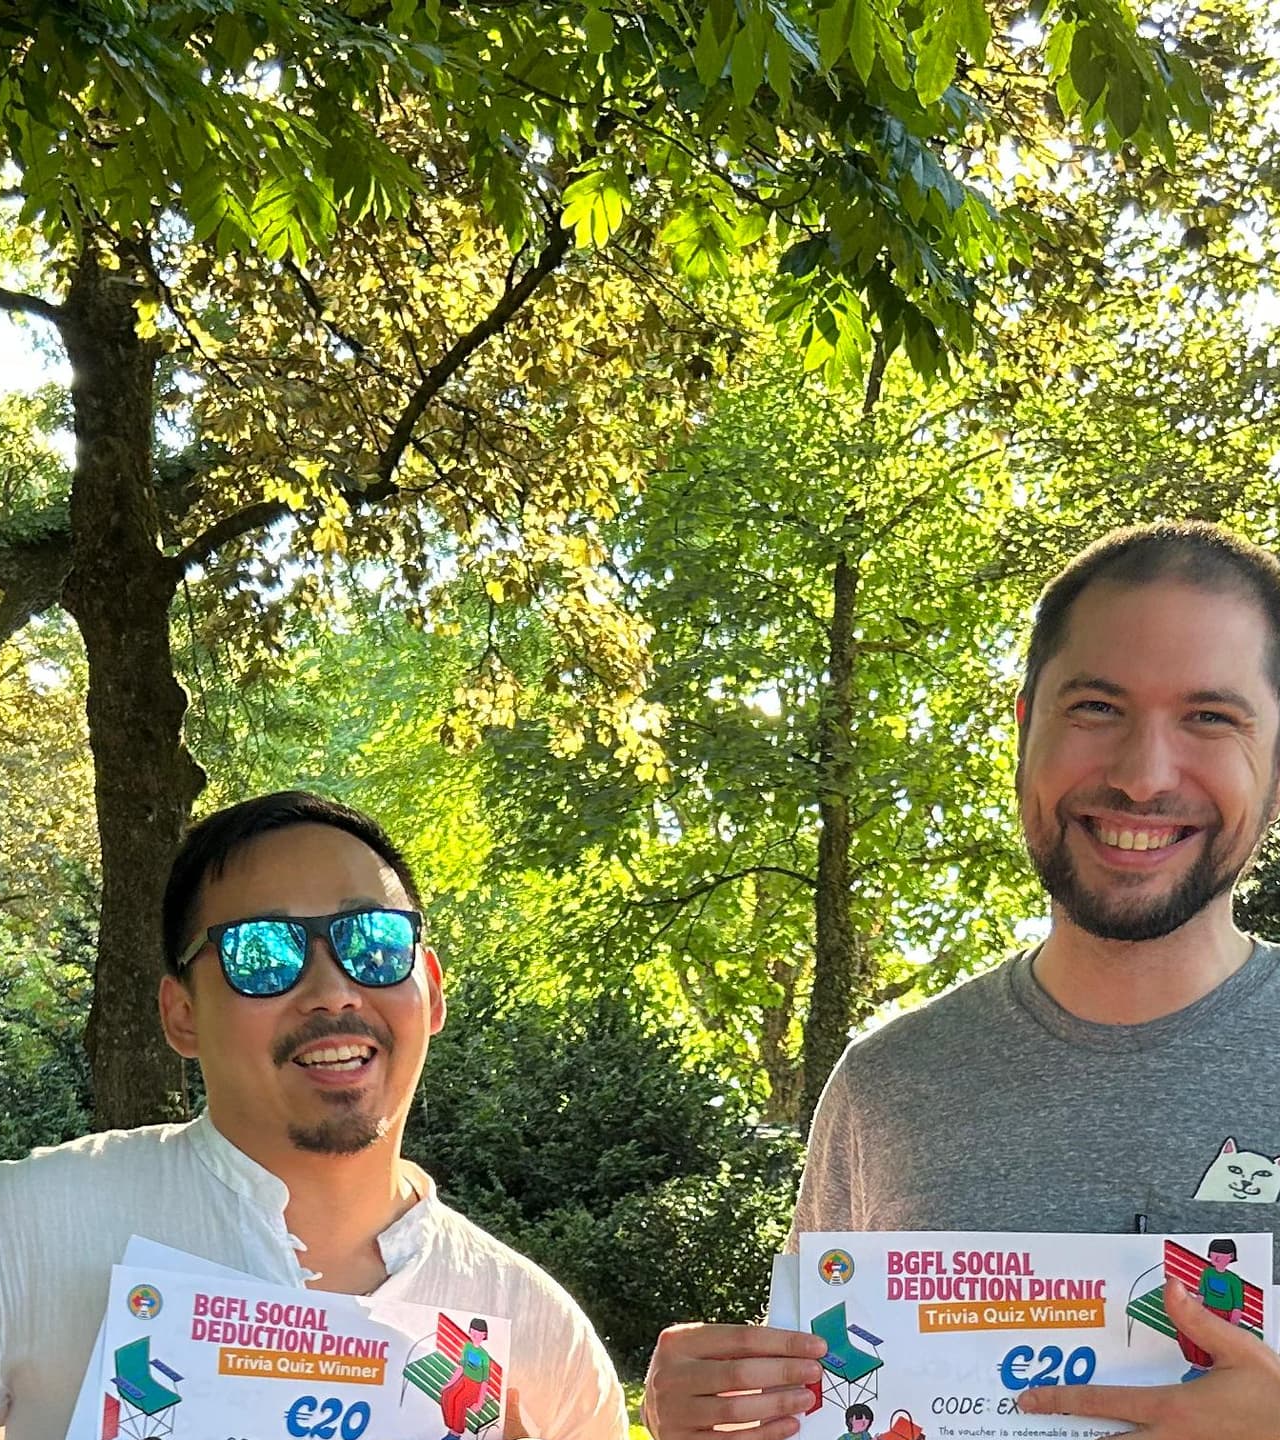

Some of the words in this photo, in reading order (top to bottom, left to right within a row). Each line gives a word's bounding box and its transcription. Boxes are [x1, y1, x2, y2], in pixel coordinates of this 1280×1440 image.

[887, 1251, 946, 1275] BGFL
[953, 1251, 1034, 1275] SOCIAL
[887, 1277, 1022, 1301] DEDUCTION
[1029, 1279, 1106, 1303] PICNIC
[193, 1294, 250, 1321] BGFL
[255, 1301, 328, 1331] SOCIAL
[926, 1309, 978, 1325] Trivia
[983, 1307, 1025, 1324] Quiz
[1029, 1305, 1097, 1322] Winner
[191, 1318, 315, 1354] DEDUCTION
[320, 1334, 389, 1362] PICNIC
[225, 1354, 272, 1371] Trivia
[277, 1358, 314, 1374] Quiz
[319, 1361, 379, 1378] Winner
[997, 1345, 1096, 1390] €20
[284, 1395, 371, 1440] €20
[931, 1396, 990, 1414] CODE:
[939, 1427, 954, 1436] The
[958, 1427, 995, 1436] voucher
[1000, 1428, 1009, 1436] is
[1012, 1428, 1068, 1437] redeemable
[1071, 1429, 1080, 1437] in
